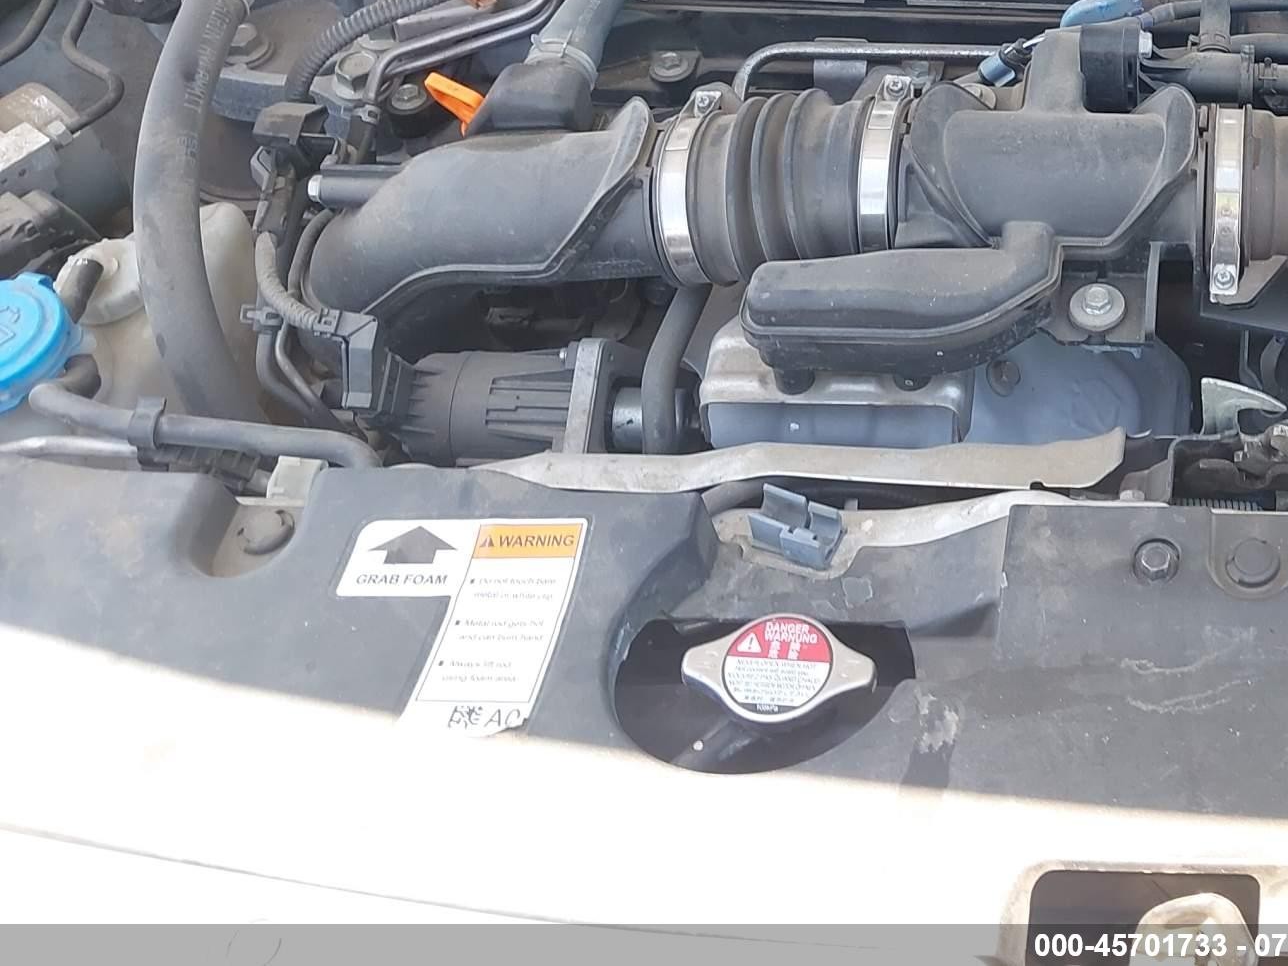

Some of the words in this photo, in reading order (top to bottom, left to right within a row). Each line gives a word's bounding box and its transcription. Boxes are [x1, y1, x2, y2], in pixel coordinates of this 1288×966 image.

[499, 534, 575, 548] WARNING
[356, 574, 399, 586] GRAB
[403, 574, 448, 585] FOAM
[765, 621, 810, 634] DANGER
